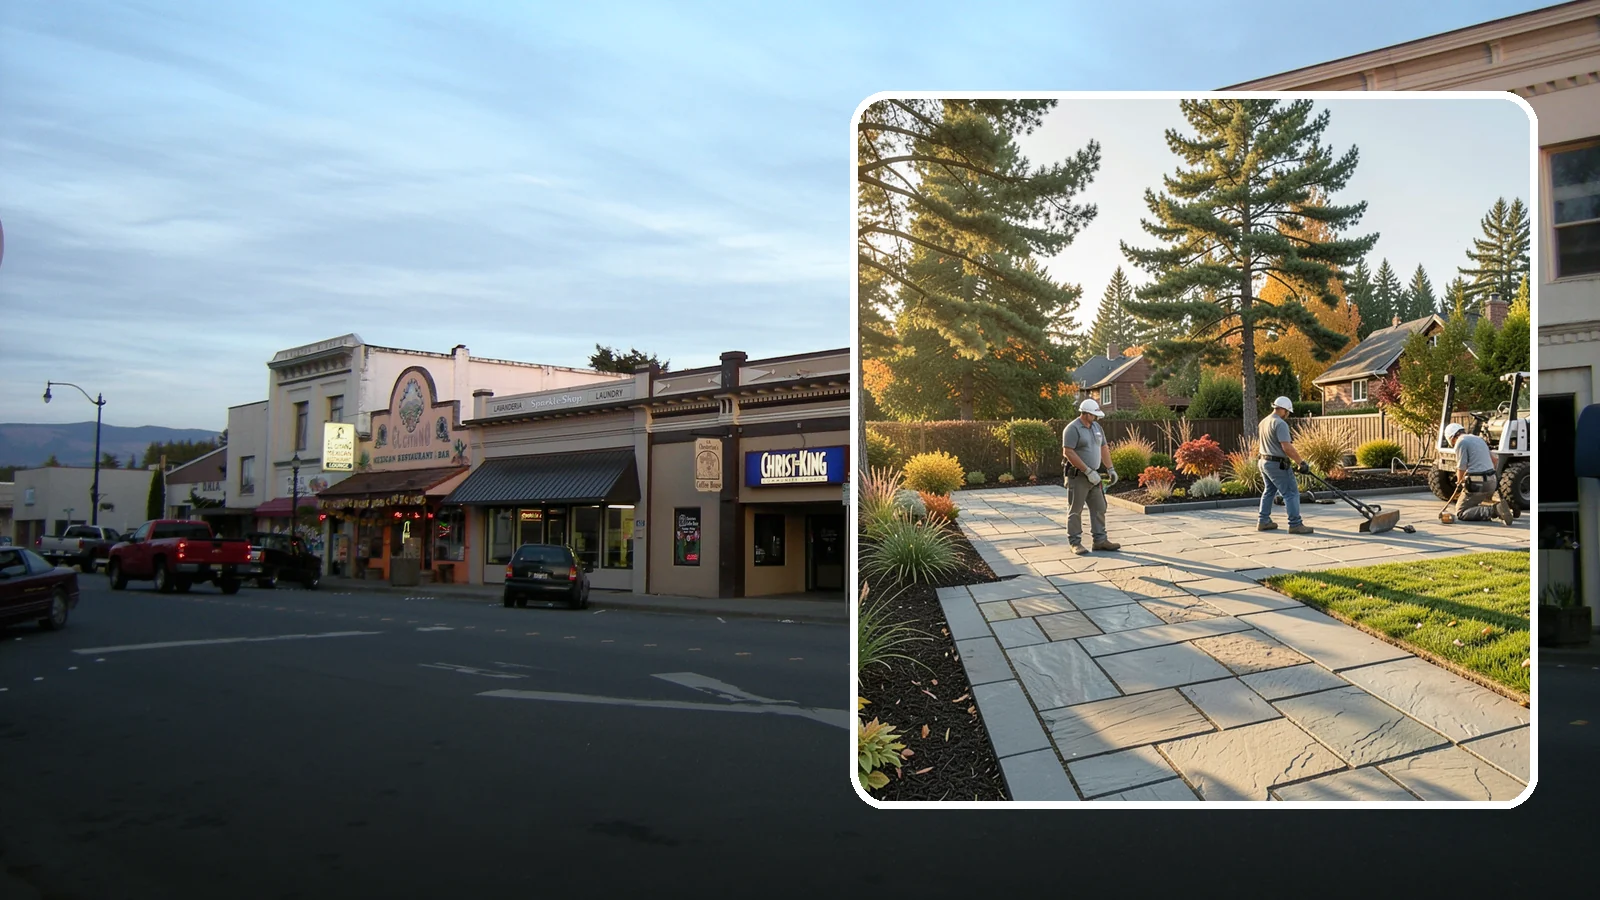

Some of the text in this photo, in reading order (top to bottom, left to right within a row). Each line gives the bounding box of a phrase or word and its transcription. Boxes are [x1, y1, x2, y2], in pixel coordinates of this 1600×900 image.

[493, 389, 623, 412] LAVANDERIA Sparkle Shop LAUNDRY
[373, 455, 396, 464] MEXICAN
[397, 451, 433, 462] RESTAURANT
[438, 450, 450, 458] BAR
[761, 450, 827, 477] CHRIST KING
